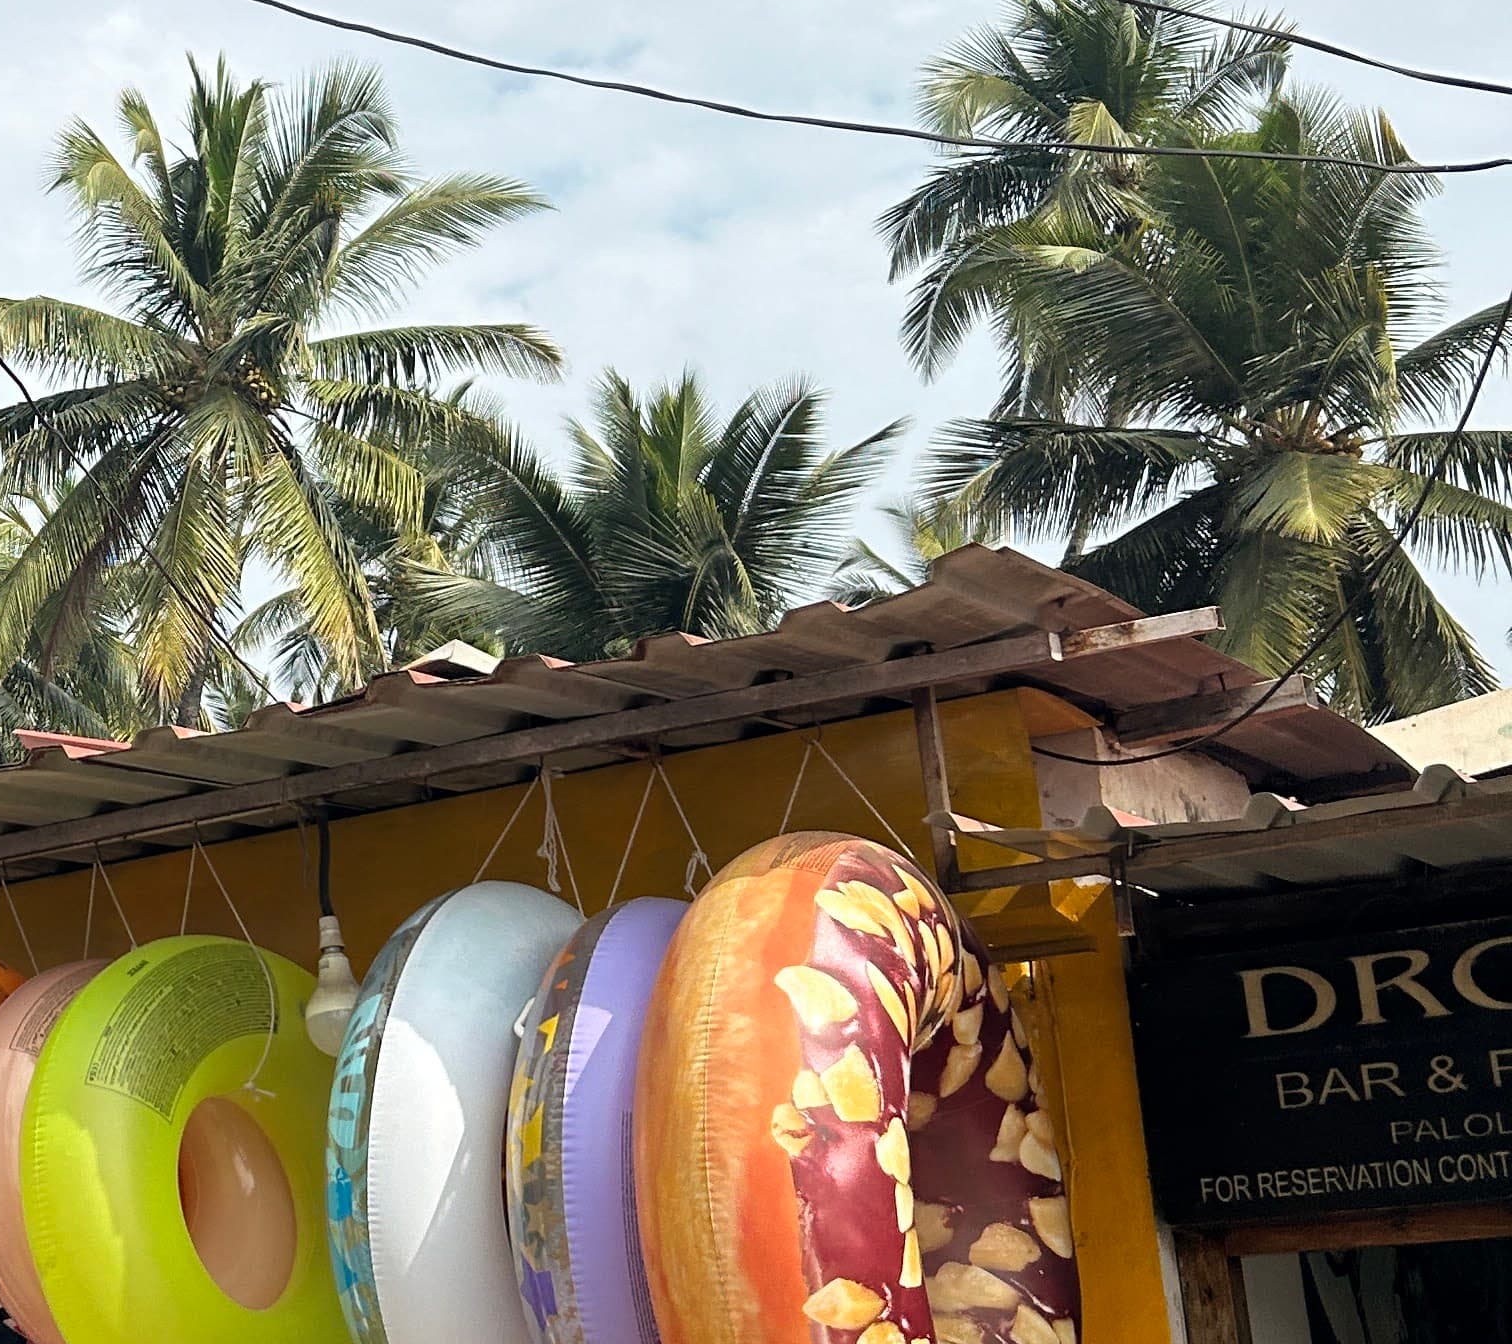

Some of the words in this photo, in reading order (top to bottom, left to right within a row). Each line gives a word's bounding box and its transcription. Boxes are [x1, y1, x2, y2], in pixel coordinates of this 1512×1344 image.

[1276, 1061, 1406, 1110] BAR
[1427, 1054, 1469, 1094] &
[1200, 1175, 1253, 1204] FOR
[1257, 1158, 1433, 1199] RESERVATION
